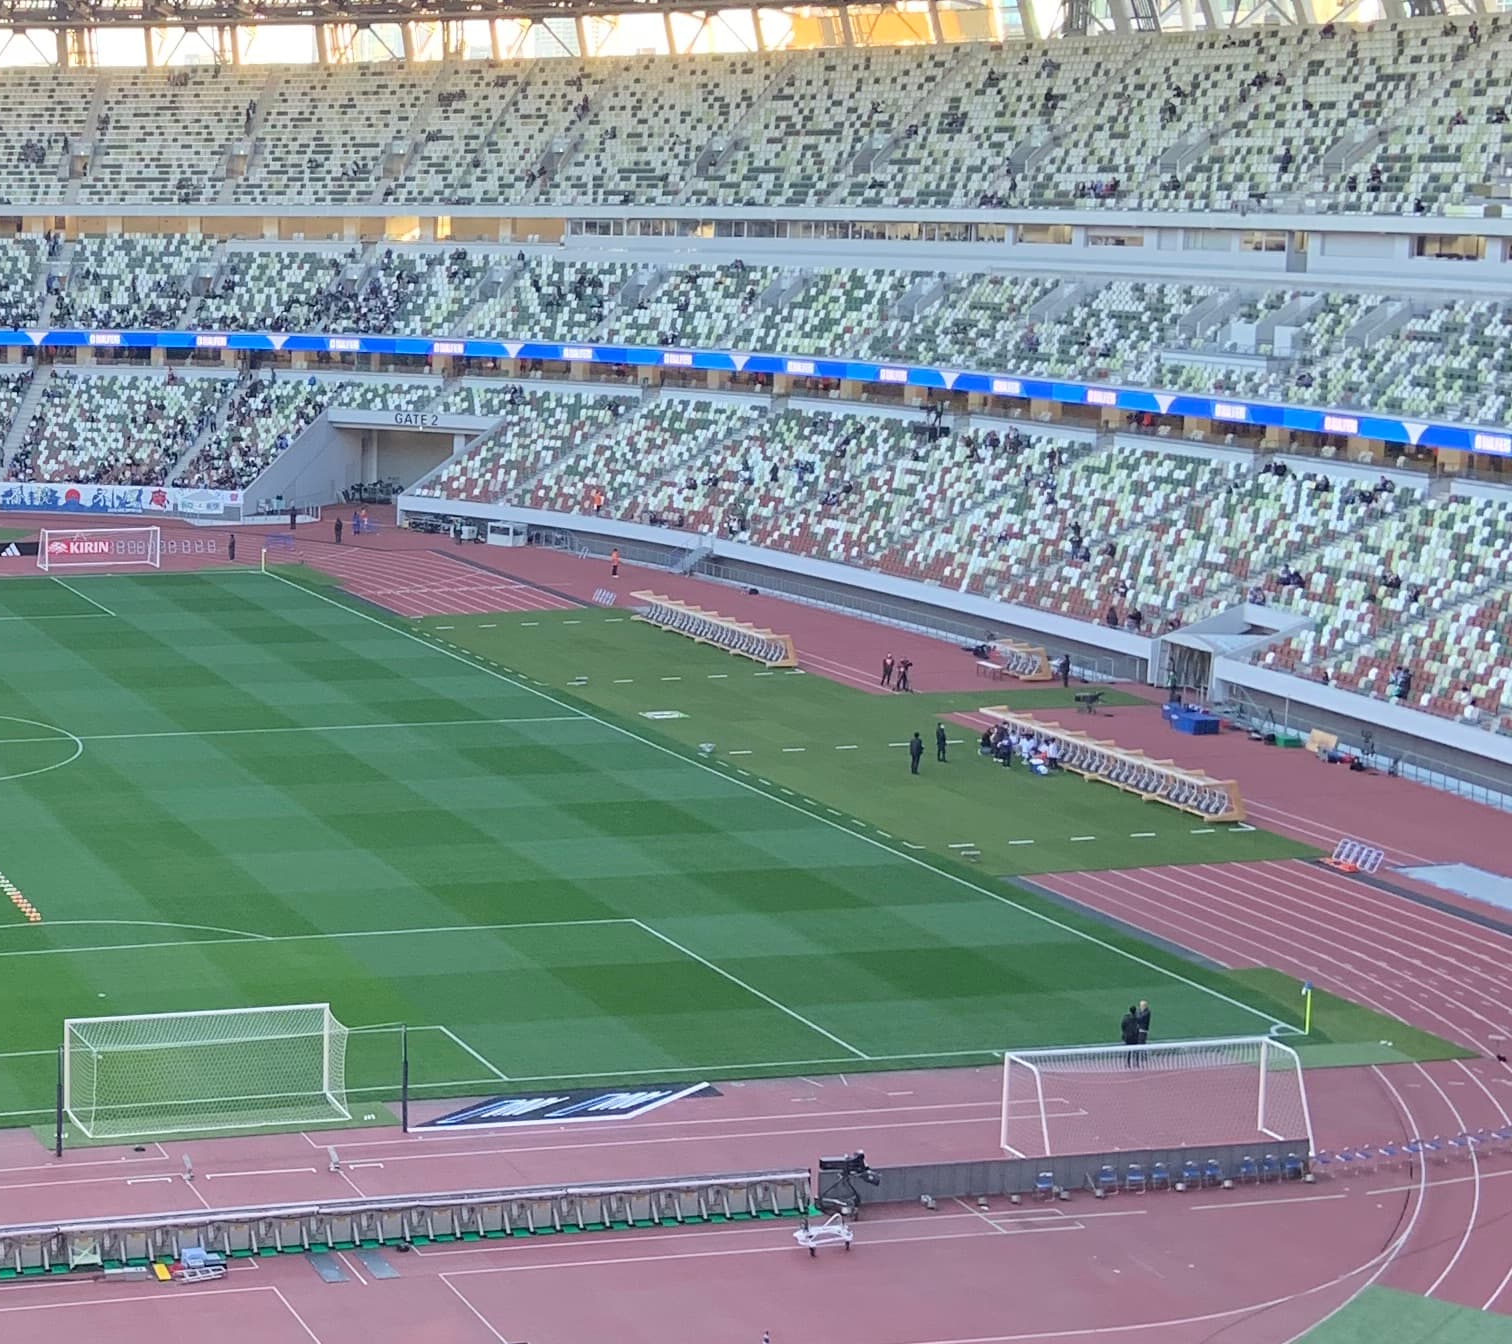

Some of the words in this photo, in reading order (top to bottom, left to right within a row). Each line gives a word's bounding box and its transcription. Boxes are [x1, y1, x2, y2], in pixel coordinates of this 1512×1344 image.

[394, 413, 428, 425] GATE
[431, 414, 439, 426] 2
[70, 541, 109, 554] KIRIN
